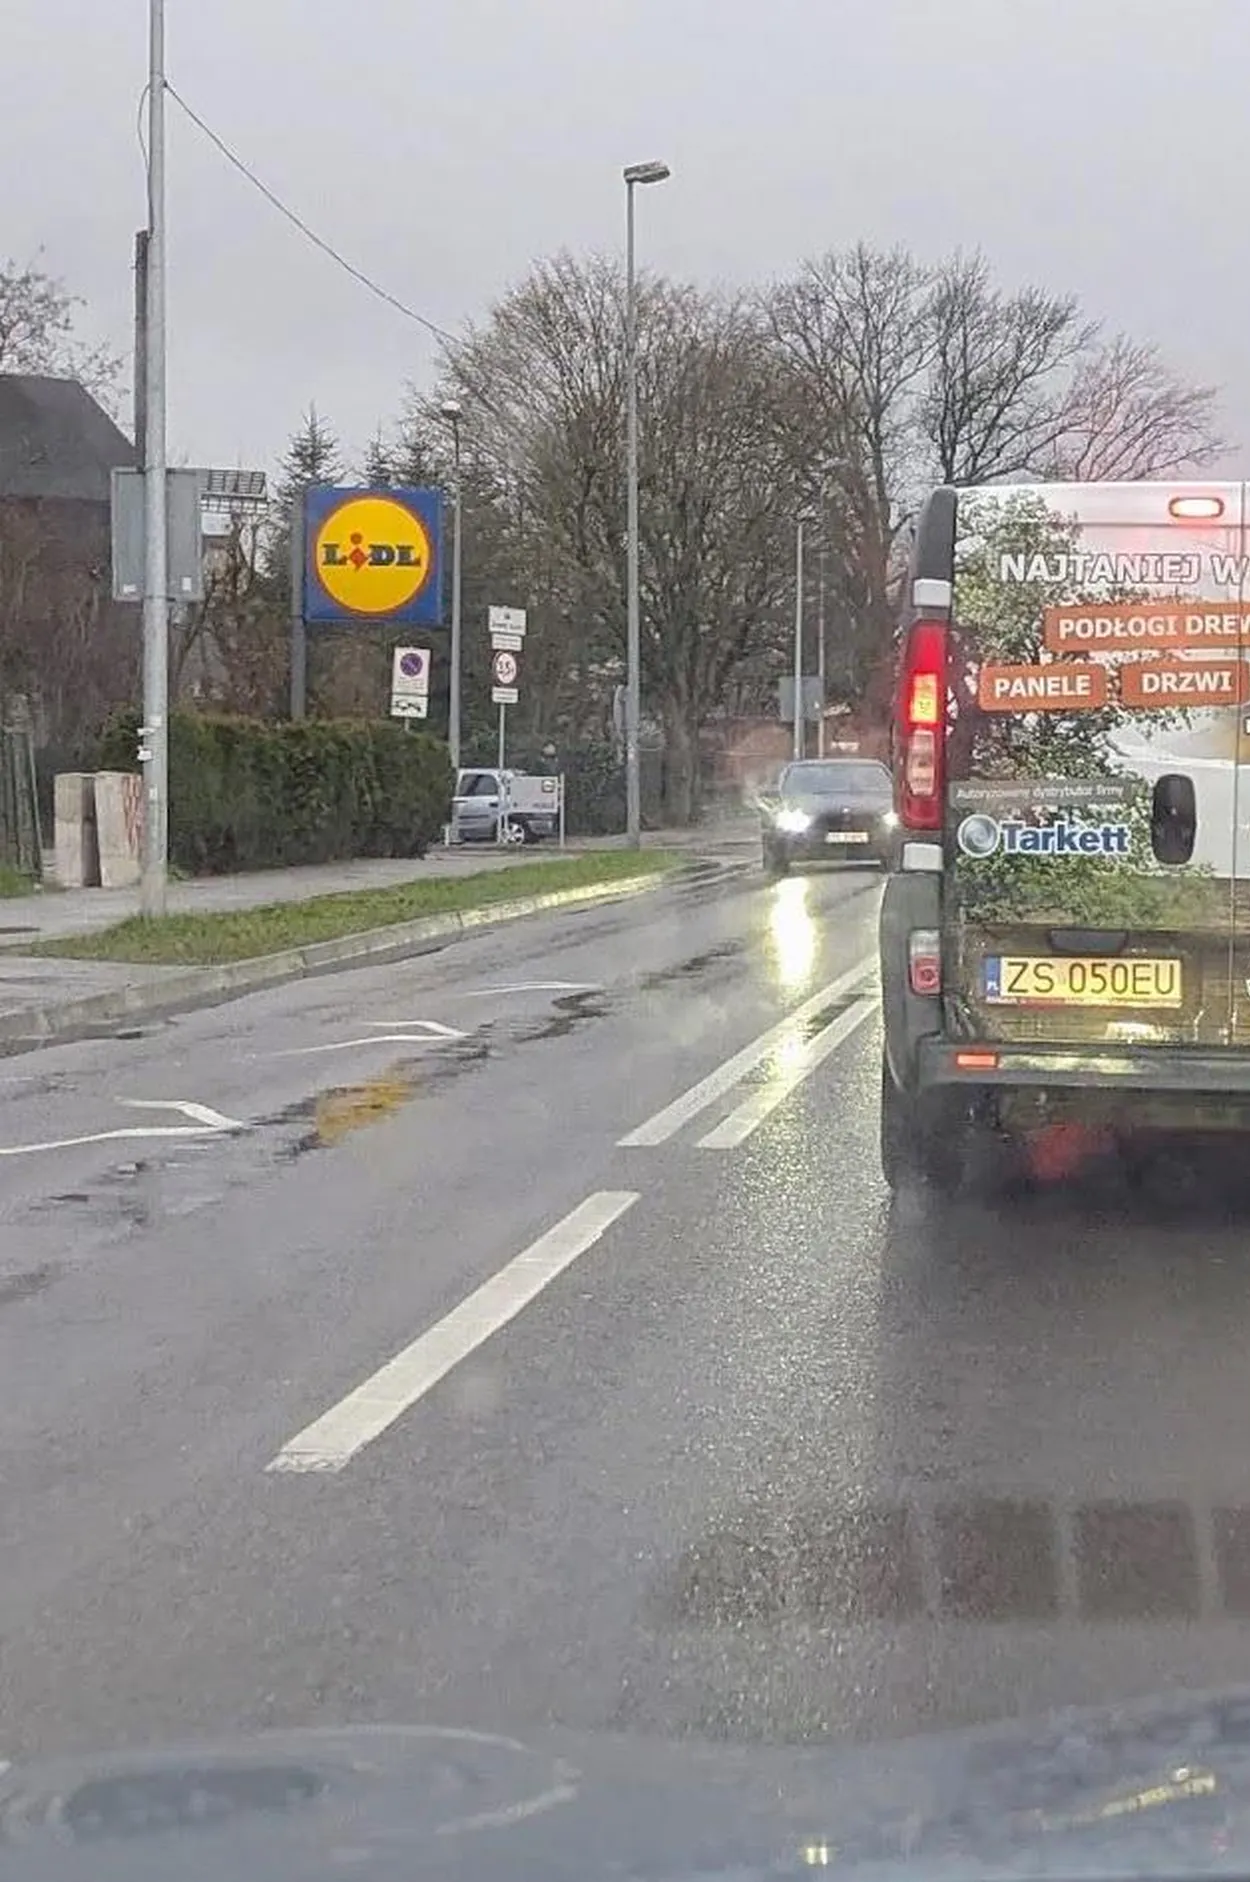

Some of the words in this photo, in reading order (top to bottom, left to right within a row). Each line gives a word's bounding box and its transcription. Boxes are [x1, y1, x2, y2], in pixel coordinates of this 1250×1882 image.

[1000, 553, 1202, 584] NAJTANIEJ
[1211, 556, 1249, 585] W
[1059, 616, 1178, 640] PODŁOGI
[994, 675, 1091, 698] PANELE
[1142, 671, 1232, 693] DRZWI
[1000, 821, 1131, 853] Tarkett
[1007, 961, 1055, 993] ZS
[1068, 962, 1175, 995] 050EU
